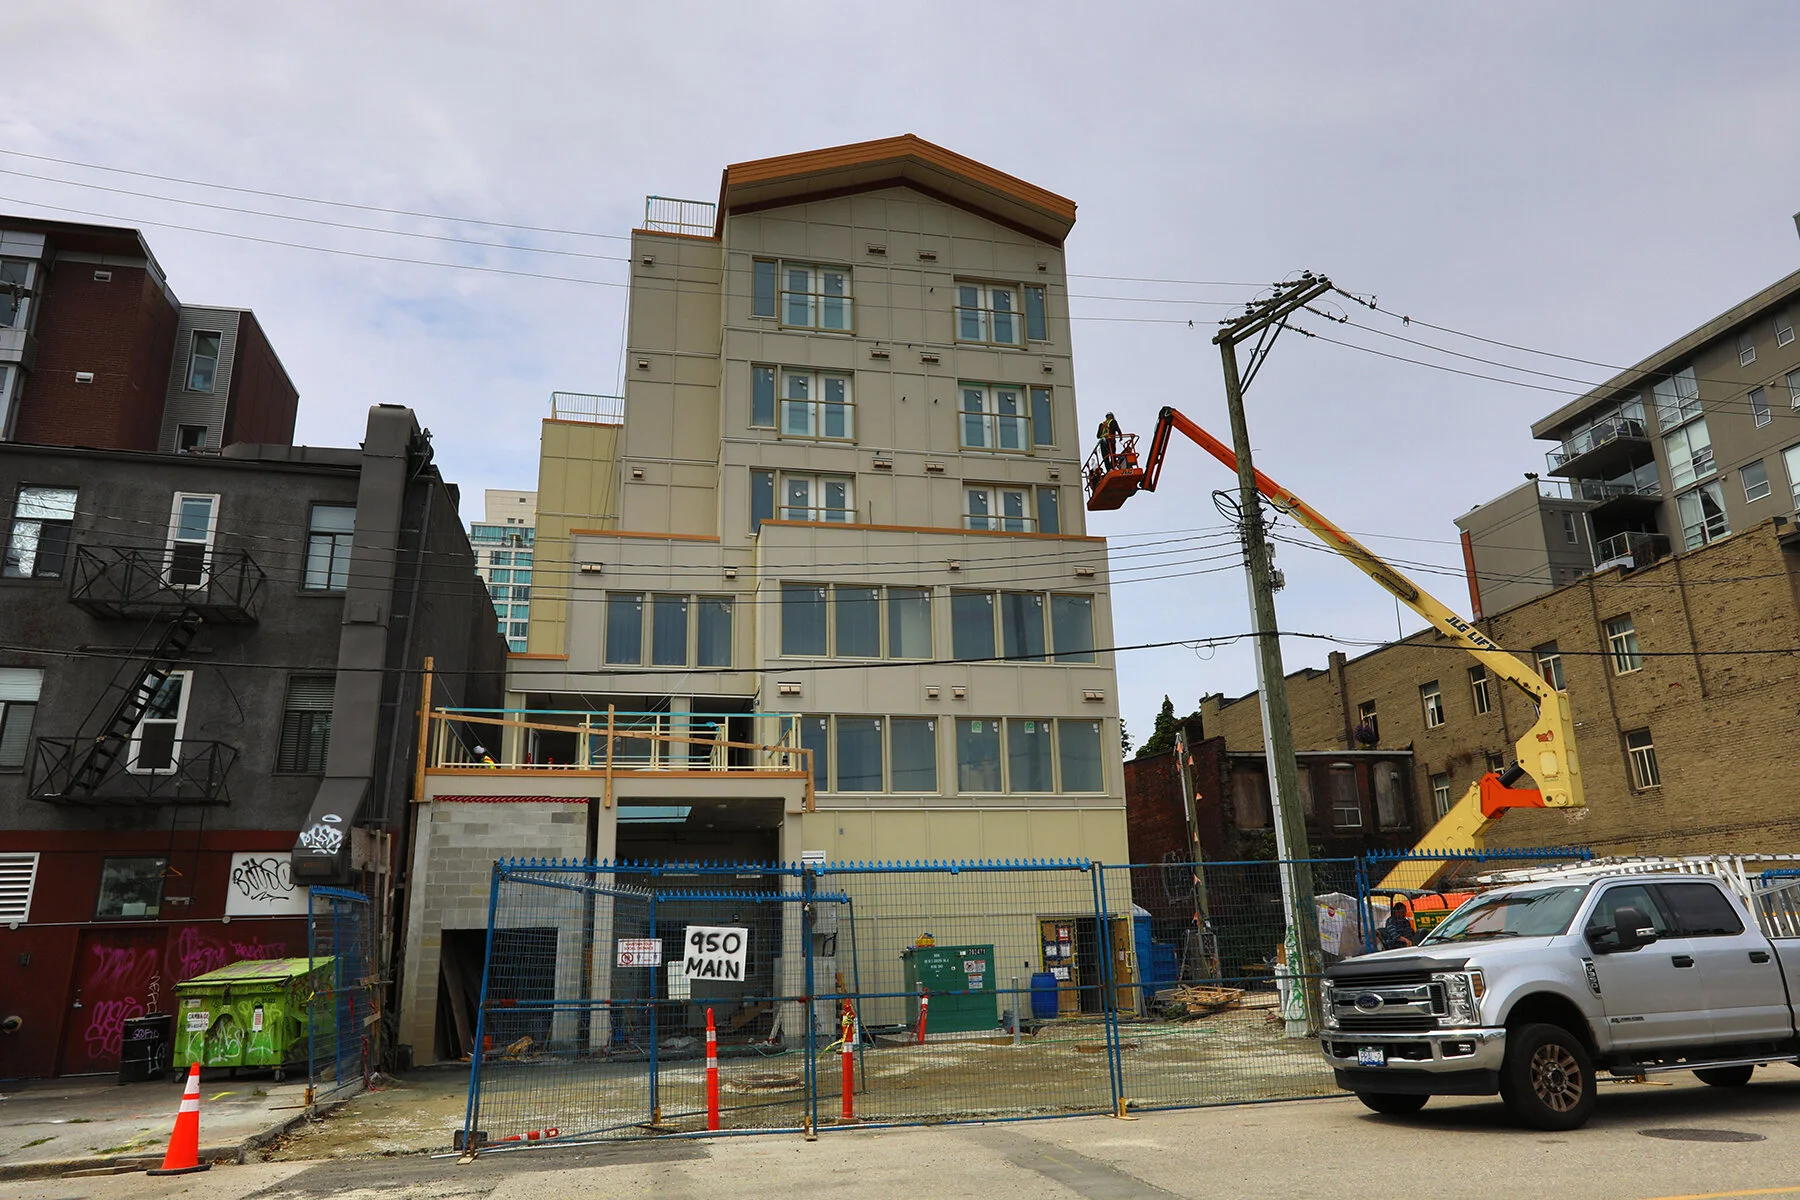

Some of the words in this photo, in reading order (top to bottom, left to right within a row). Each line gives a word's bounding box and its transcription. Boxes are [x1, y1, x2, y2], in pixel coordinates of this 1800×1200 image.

[1444, 616, 1470, 633] JLG
[1466, 631, 1497, 652] LIFT
[690, 931, 741, 954] 950
[685, 957, 740, 979] MAIN
